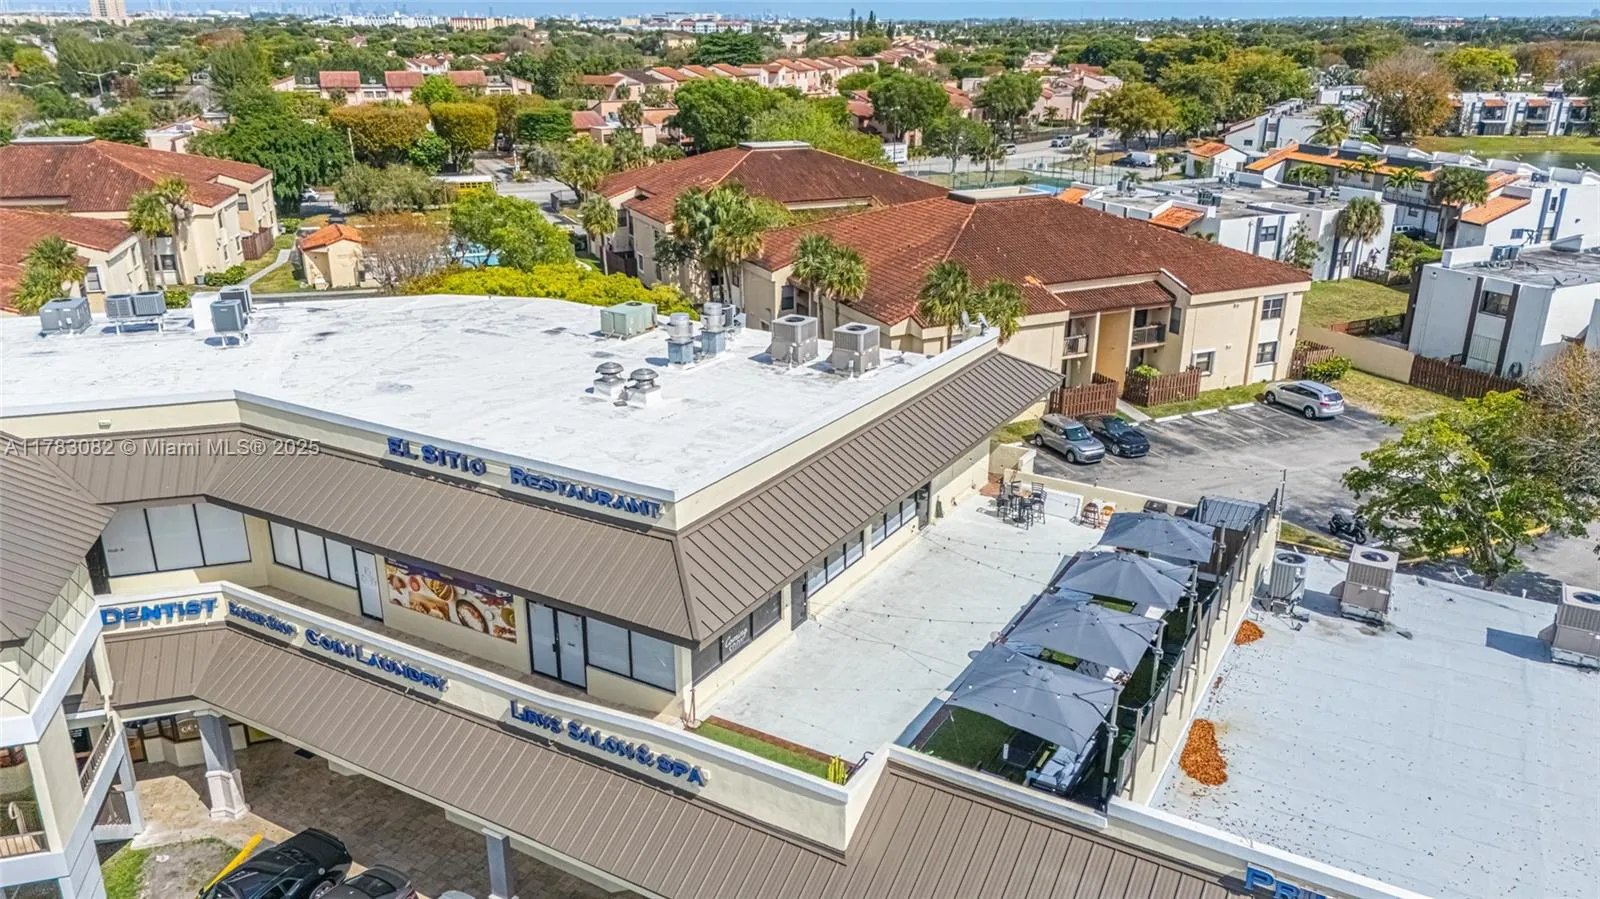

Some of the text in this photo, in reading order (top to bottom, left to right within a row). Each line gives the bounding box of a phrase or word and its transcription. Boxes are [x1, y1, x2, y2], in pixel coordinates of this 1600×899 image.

[387, 437, 419, 460] EL
[421, 445, 486, 476] SITIO
[100, 597, 217, 625] DENTIST
[656, 753, 710, 787] SPA
